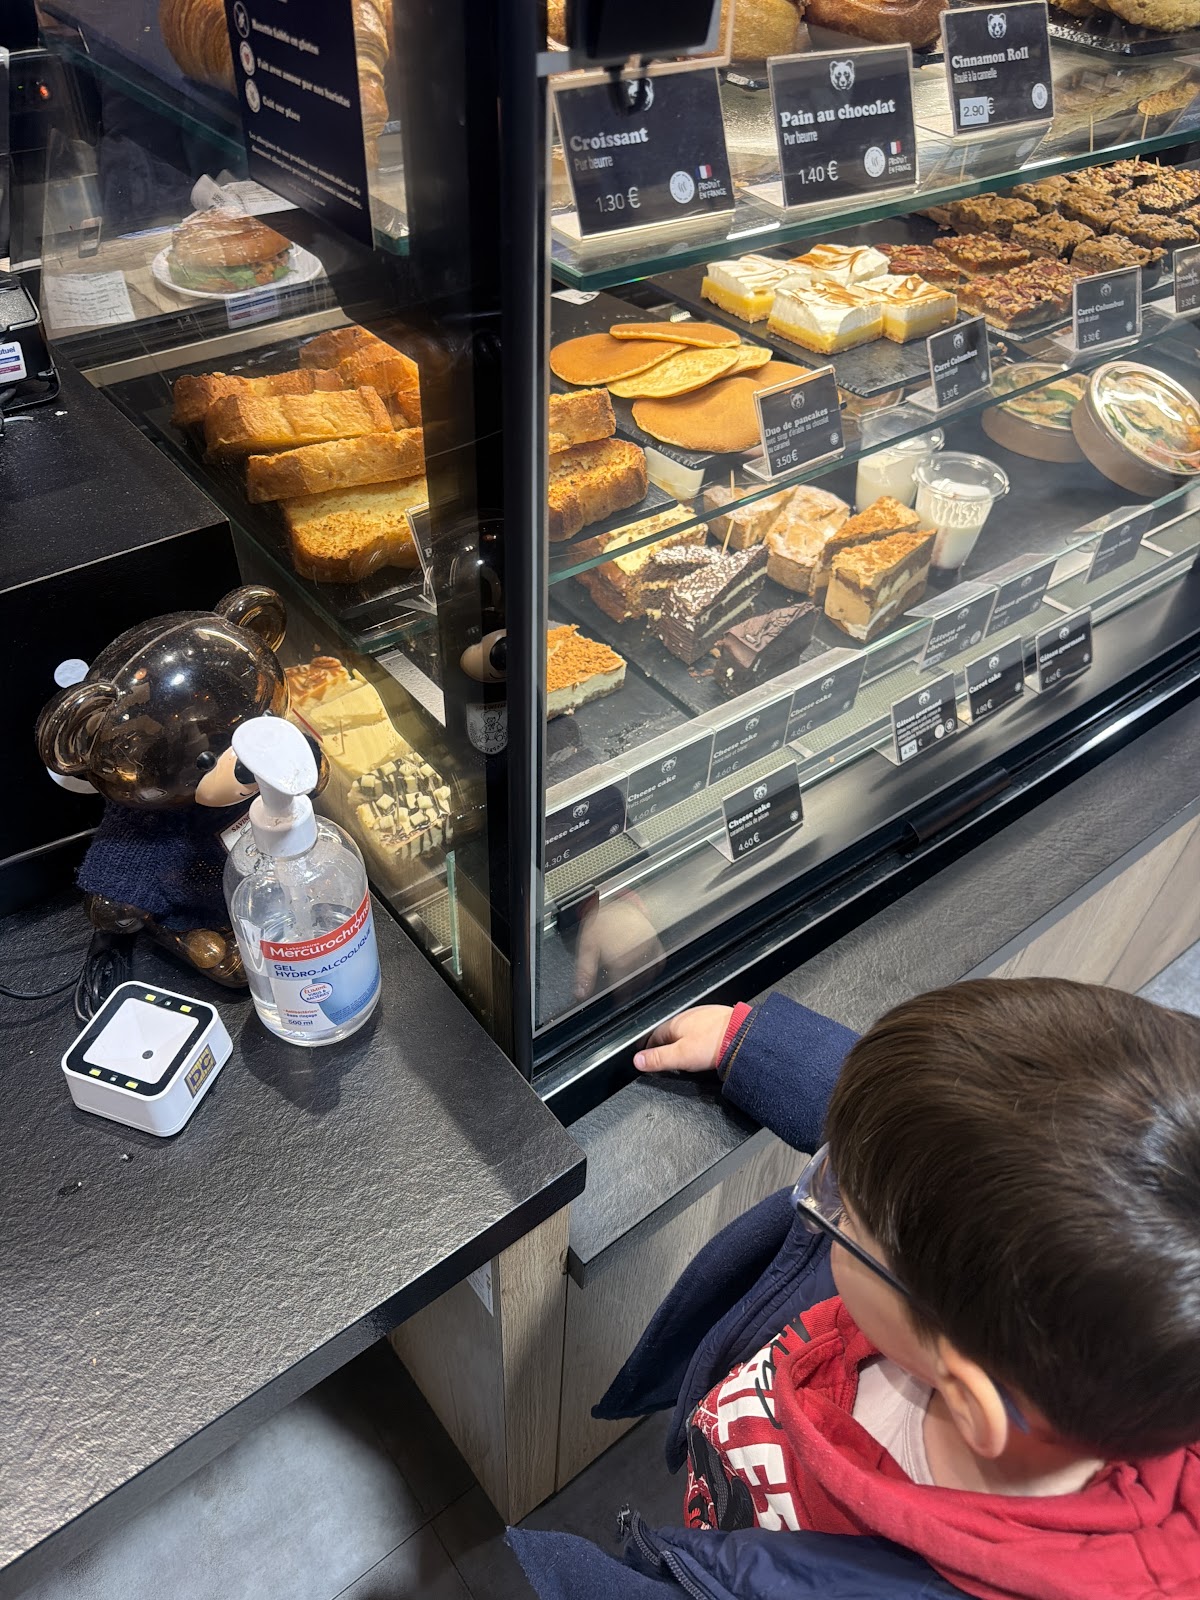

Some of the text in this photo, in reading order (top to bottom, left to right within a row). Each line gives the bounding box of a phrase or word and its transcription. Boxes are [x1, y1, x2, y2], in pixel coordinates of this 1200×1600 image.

[952, 46, 1029, 69] Cinnamon Roll
[977, 67, 997, 80] cannelle
[780, 99, 896, 127] Pain au chocolat
[963, 105, 985, 117] 2.90
[570, 128, 649, 151] Croissant
[784, 130, 818, 146] Pur beurre
[574, 156, 613, 171] Pur beurre
[707, 188, 727, 198] FRANCE
[1077, 305, 1094, 316] Carré
[934, 360, 950, 372] Carré
[765, 408, 828, 438] Duo de pancakes
[774, 439, 790, 452] caramel
[930, 629, 956, 645] Gâteau
[1040, 649, 1059, 663] Gâteau
[969, 672, 1002, 694] Carrot cake
[791, 693, 832, 717] Cheese cake
[897, 715, 915, 728] Gâteau
[714, 733, 758, 758] Cheese cake
[628, 775, 676, 802] Cheese cake
[729, 802, 771, 829] Cheese cake
[545, 819, 590, 845] heese cake
[270, 900, 370, 958] Mercurochrome
[286, 942, 320, 950] Laboratoires
[274, 964, 296, 972] GEL
